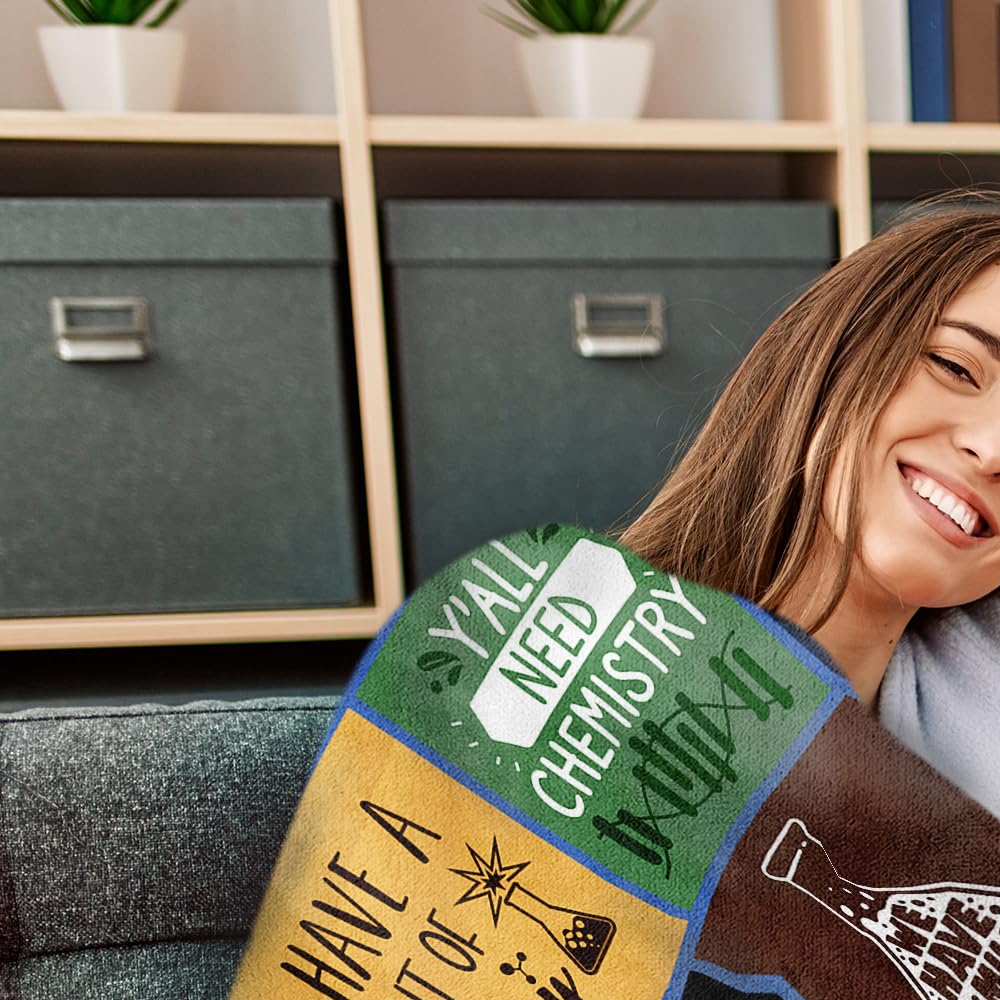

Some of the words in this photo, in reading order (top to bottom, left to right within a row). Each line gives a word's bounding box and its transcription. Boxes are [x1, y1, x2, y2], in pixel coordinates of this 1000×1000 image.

[428, 540, 549, 660] Y'ALL
[499, 596, 598, 704] NEED
[531, 574, 707, 818] CHEMISTRY
[360, 801, 442, 864] A
[419, 908, 484, 972] OF
[885, 903, 938, 956] WE
